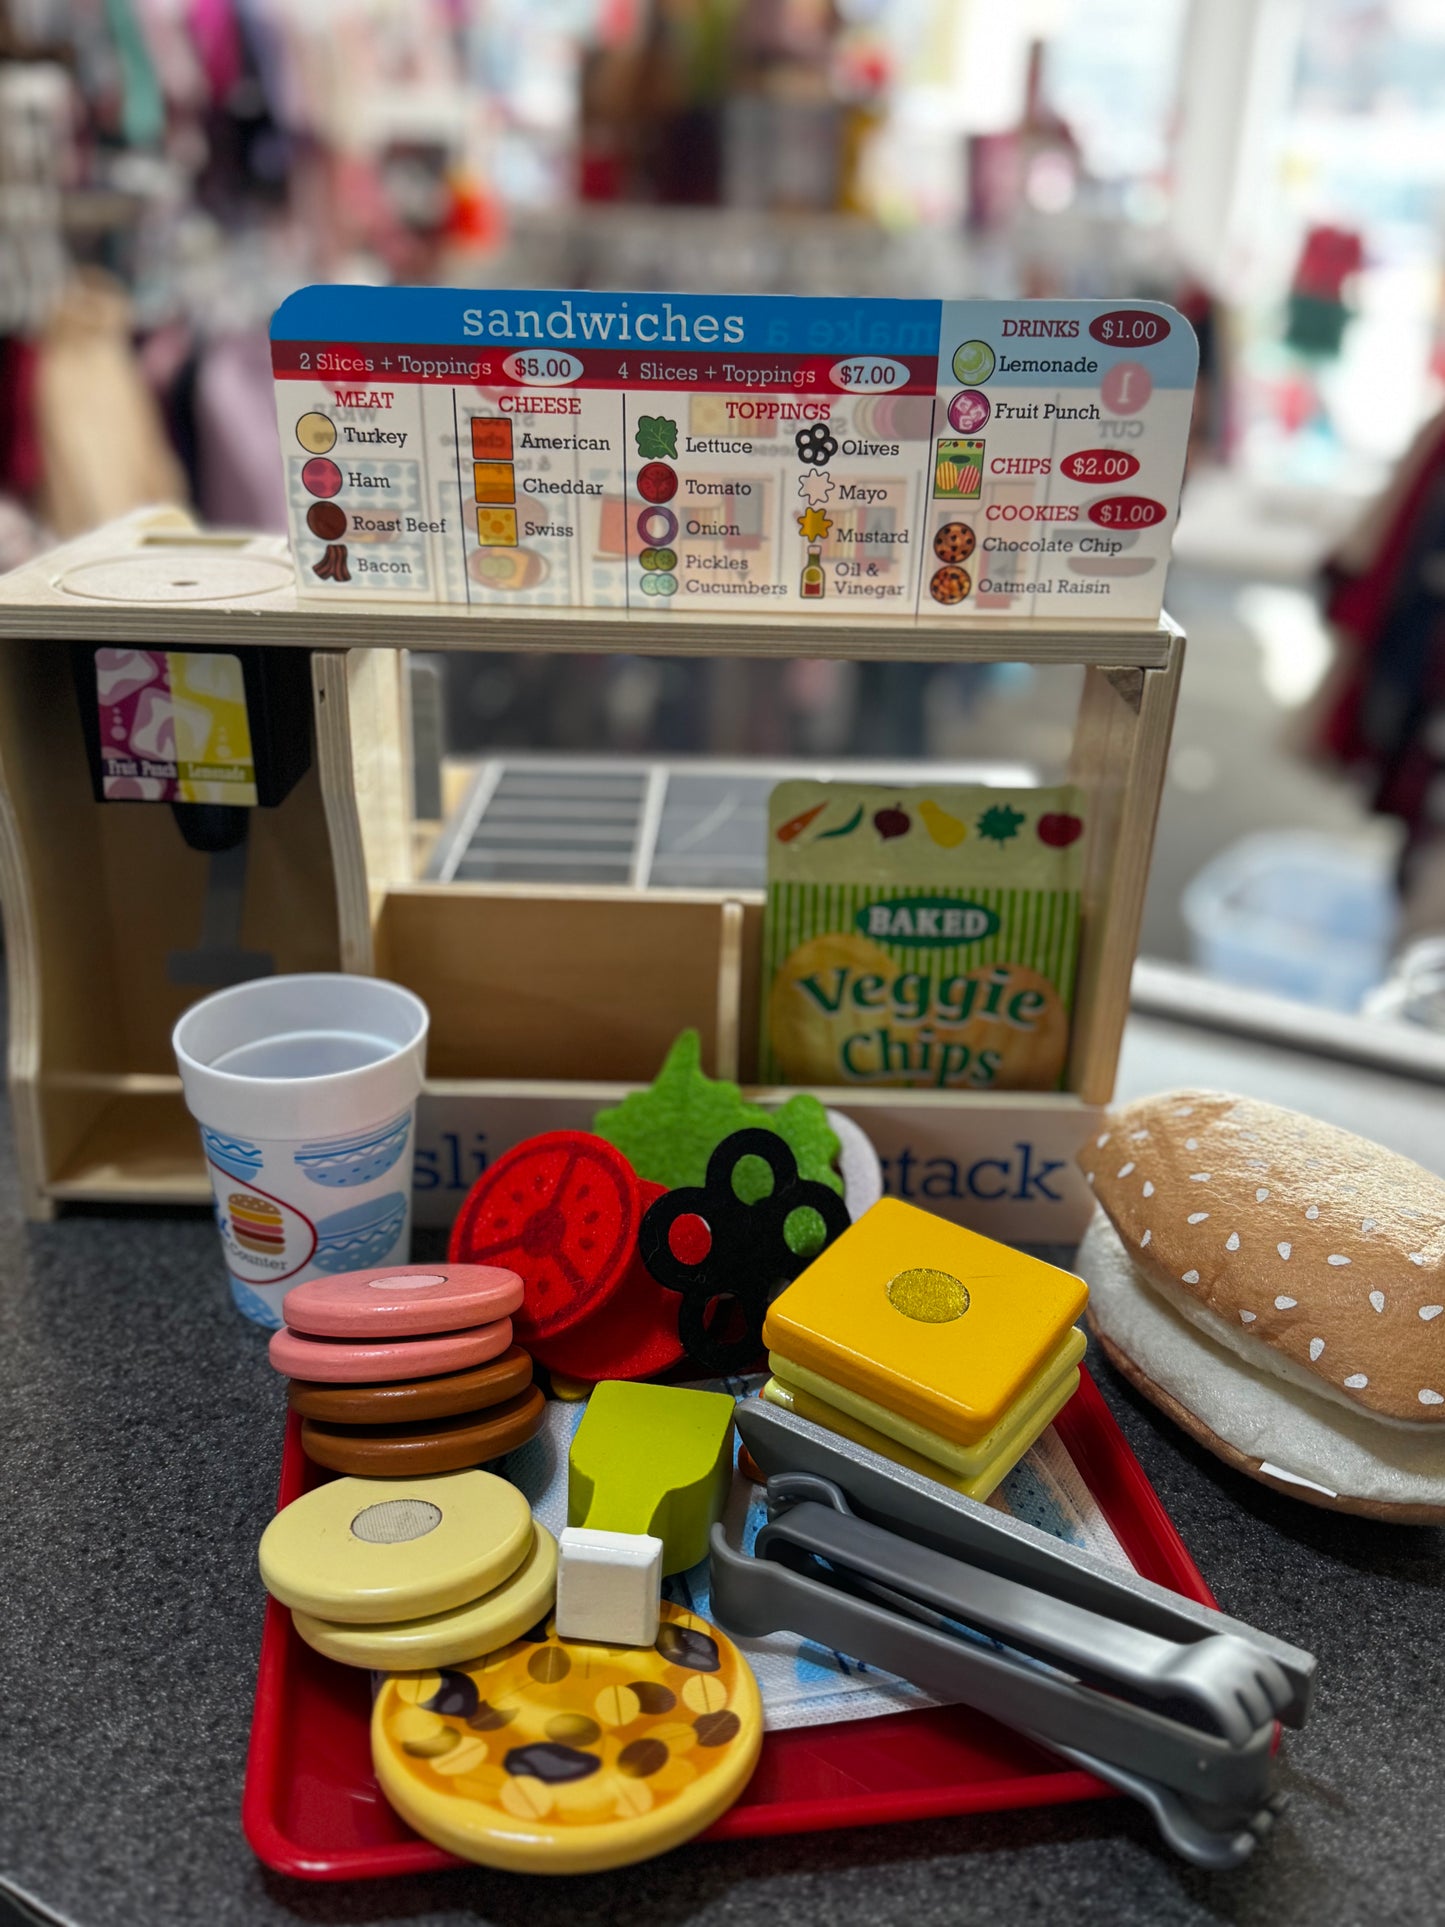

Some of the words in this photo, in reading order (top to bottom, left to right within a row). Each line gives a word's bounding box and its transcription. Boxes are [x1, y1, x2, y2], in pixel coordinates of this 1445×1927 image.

[463, 301, 746, 343] sandwiches
[1002, 320, 1080, 339] DRINKS
[1101, 319, 1158, 340] $1.00
[300, 353, 311, 370] 2
[316, 353, 374, 372] Slices
[380, 357, 393, 370] +
[399, 355, 492, 380] Toppings
[514, 358, 572, 379] $5.00
[998, 356, 1098, 373] Lemonade
[618, 363, 629, 379] 4
[640, 363, 698, 381] Slices
[704, 366, 717, 379] +
[722, 365, 816, 389] Toppings
[840, 365, 896, 386] $7.00
[335, 391, 394, 409] MEAT
[499, 395, 582, 415] CHEESE
[726, 402, 831, 420] TOPPINGS
[995, 403, 1040, 420] Fruit
[1044, 404, 1100, 420] Punch
[343, 427, 408, 448] Turkey
[520, 433, 611, 452] American
[685, 436, 753, 454] Lettuce
[841, 440, 900, 457] Olives
[991, 458, 1052, 475] CHIPS
[1072, 457, 1130, 476] $2.00
[348, 473, 391, 489] Ham
[523, 478, 604, 496] Cheddar
[686, 479, 752, 496] Tomato
[839, 486, 888, 502] Mayo
[986, 505, 1079, 522] COOKIES
[1100, 504, 1156, 523] $1.00
[352, 516, 401, 532] Roast
[405, 518, 447, 534] Beef
[525, 521, 574, 537] Swiss
[686, 521, 741, 537] Onion
[836, 528, 910, 544] Mustard
[982, 536, 1073, 553] Chocolate
[1078, 538, 1122, 556] Chip
[358, 558, 412, 574] Bacon
[686, 554, 749, 570] Pickles
[835, 562, 863, 577] Oil
[867, 562, 879, 577] &
[686, 579, 788, 595] Cucumbers
[835, 581, 905, 598] Vinegar
[979, 579, 1052, 595] Oatmeal
[1057, 579, 1111, 595] Raisin
[869, 907, 988, 938] BAKED
[796, 966, 1046, 1028] Veggie
[841, 1028, 1001, 1088] Chips
[413, 1131, 490, 1190] sli
